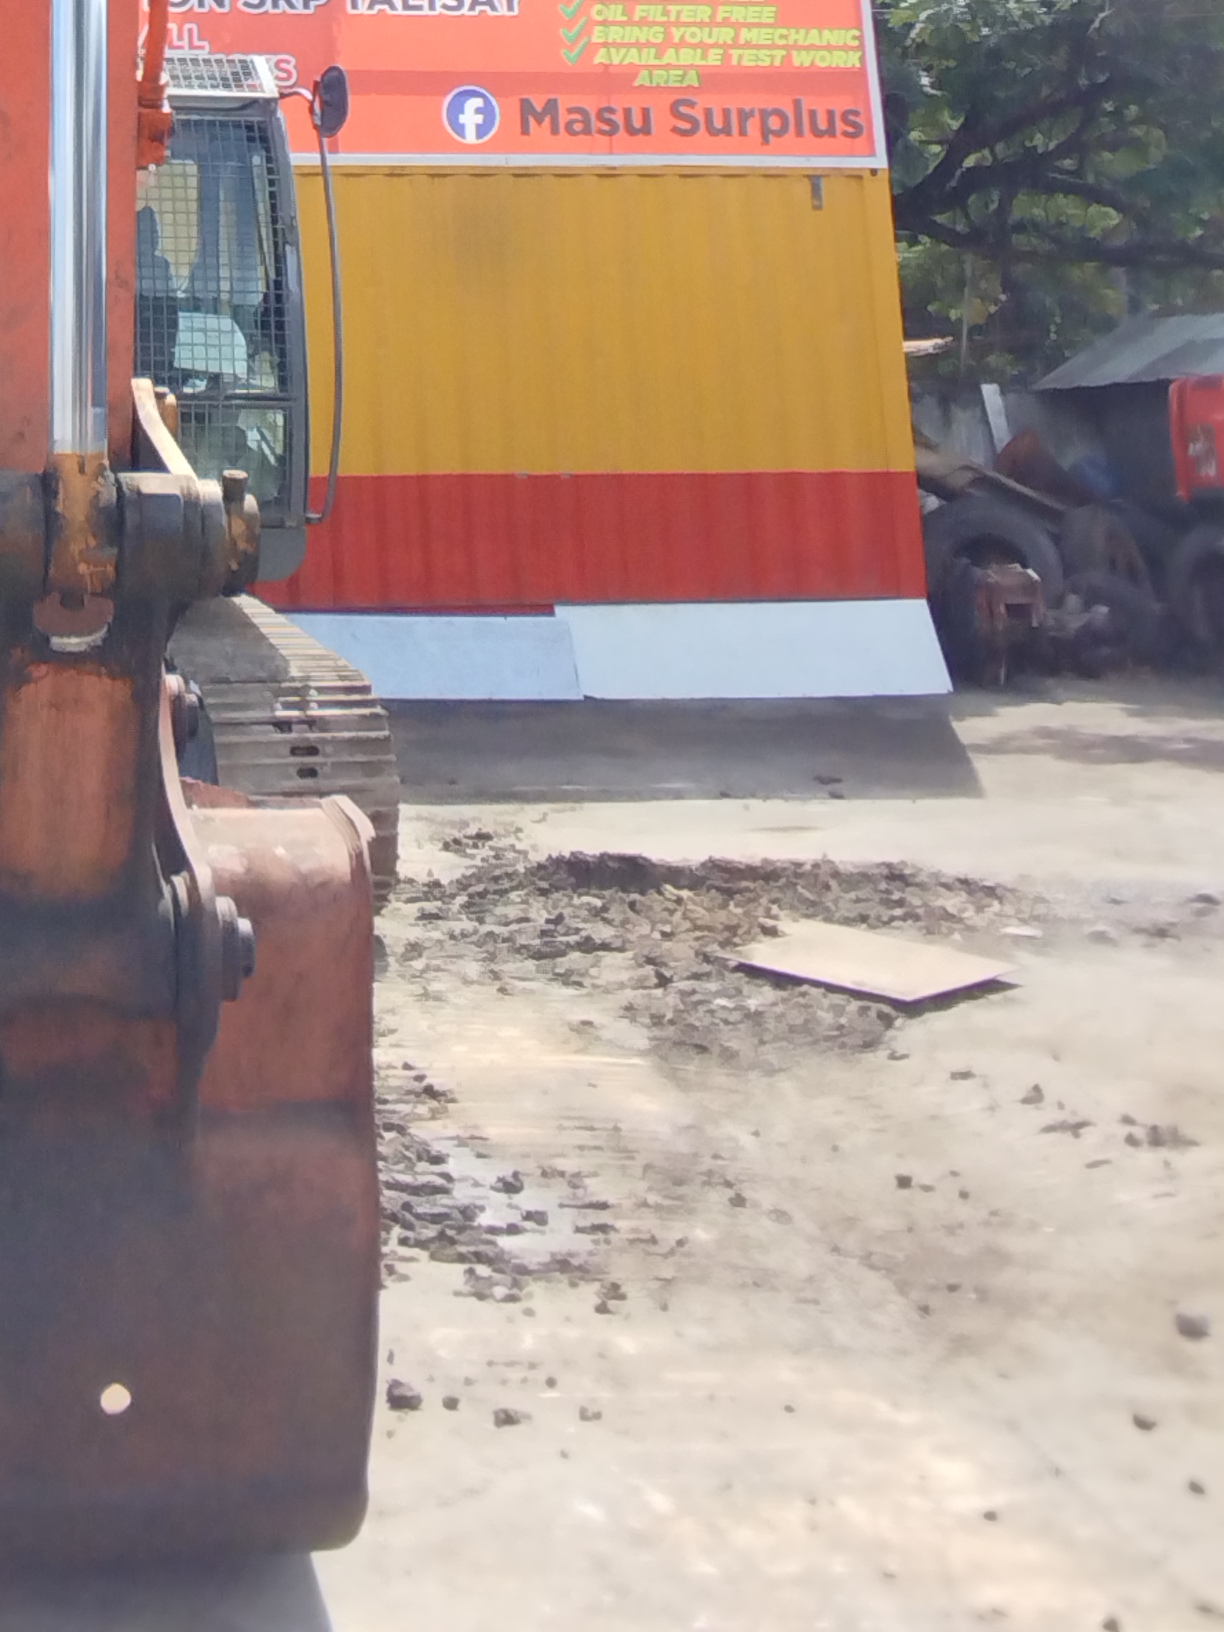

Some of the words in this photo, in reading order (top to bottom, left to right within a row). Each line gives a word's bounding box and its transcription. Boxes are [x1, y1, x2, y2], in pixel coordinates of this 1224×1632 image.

[591, 3, 628, 21] OIL
[633, 4, 714, 22] FILTER
[716, 5, 777, 23] FREE
[591, 25, 666, 43] BRING
[671, 26, 736, 44] YOUR
[738, 27, 861, 47] MECHANIC
[593, 47, 723, 66] AVAILABLE
[728, 48, 786, 66] TEST
[790, 49, 862, 68] WORK
[633, 68, 701, 87] AREA
[520, 97, 654, 137] Masu
[669, 97, 865, 146] Surplus
